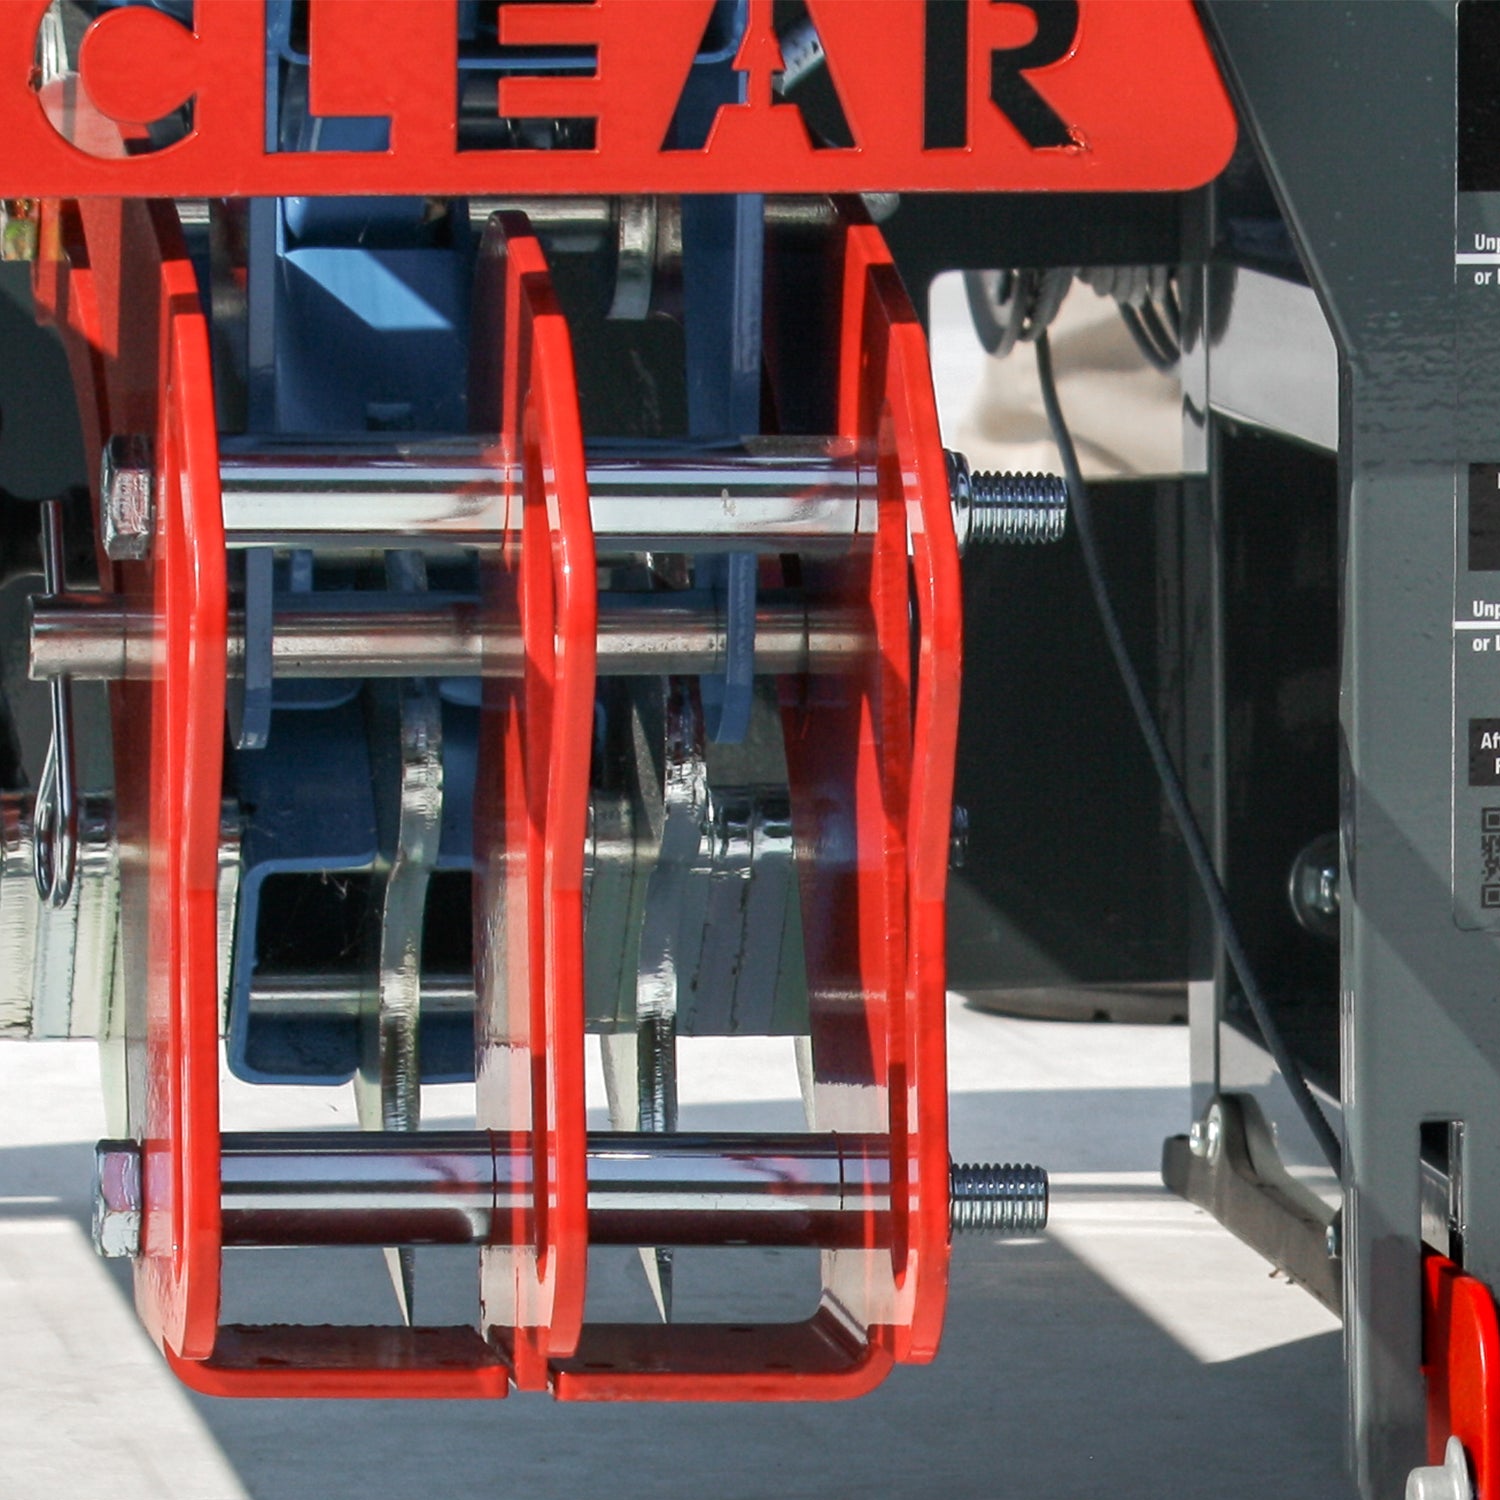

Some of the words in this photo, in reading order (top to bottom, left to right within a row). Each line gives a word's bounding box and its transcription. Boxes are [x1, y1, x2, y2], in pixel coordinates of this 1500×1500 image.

[33, 0, 1084, 160] CLEAR
[1474, 271, 1492, 285] or
[1472, 638, 1491, 652] or
